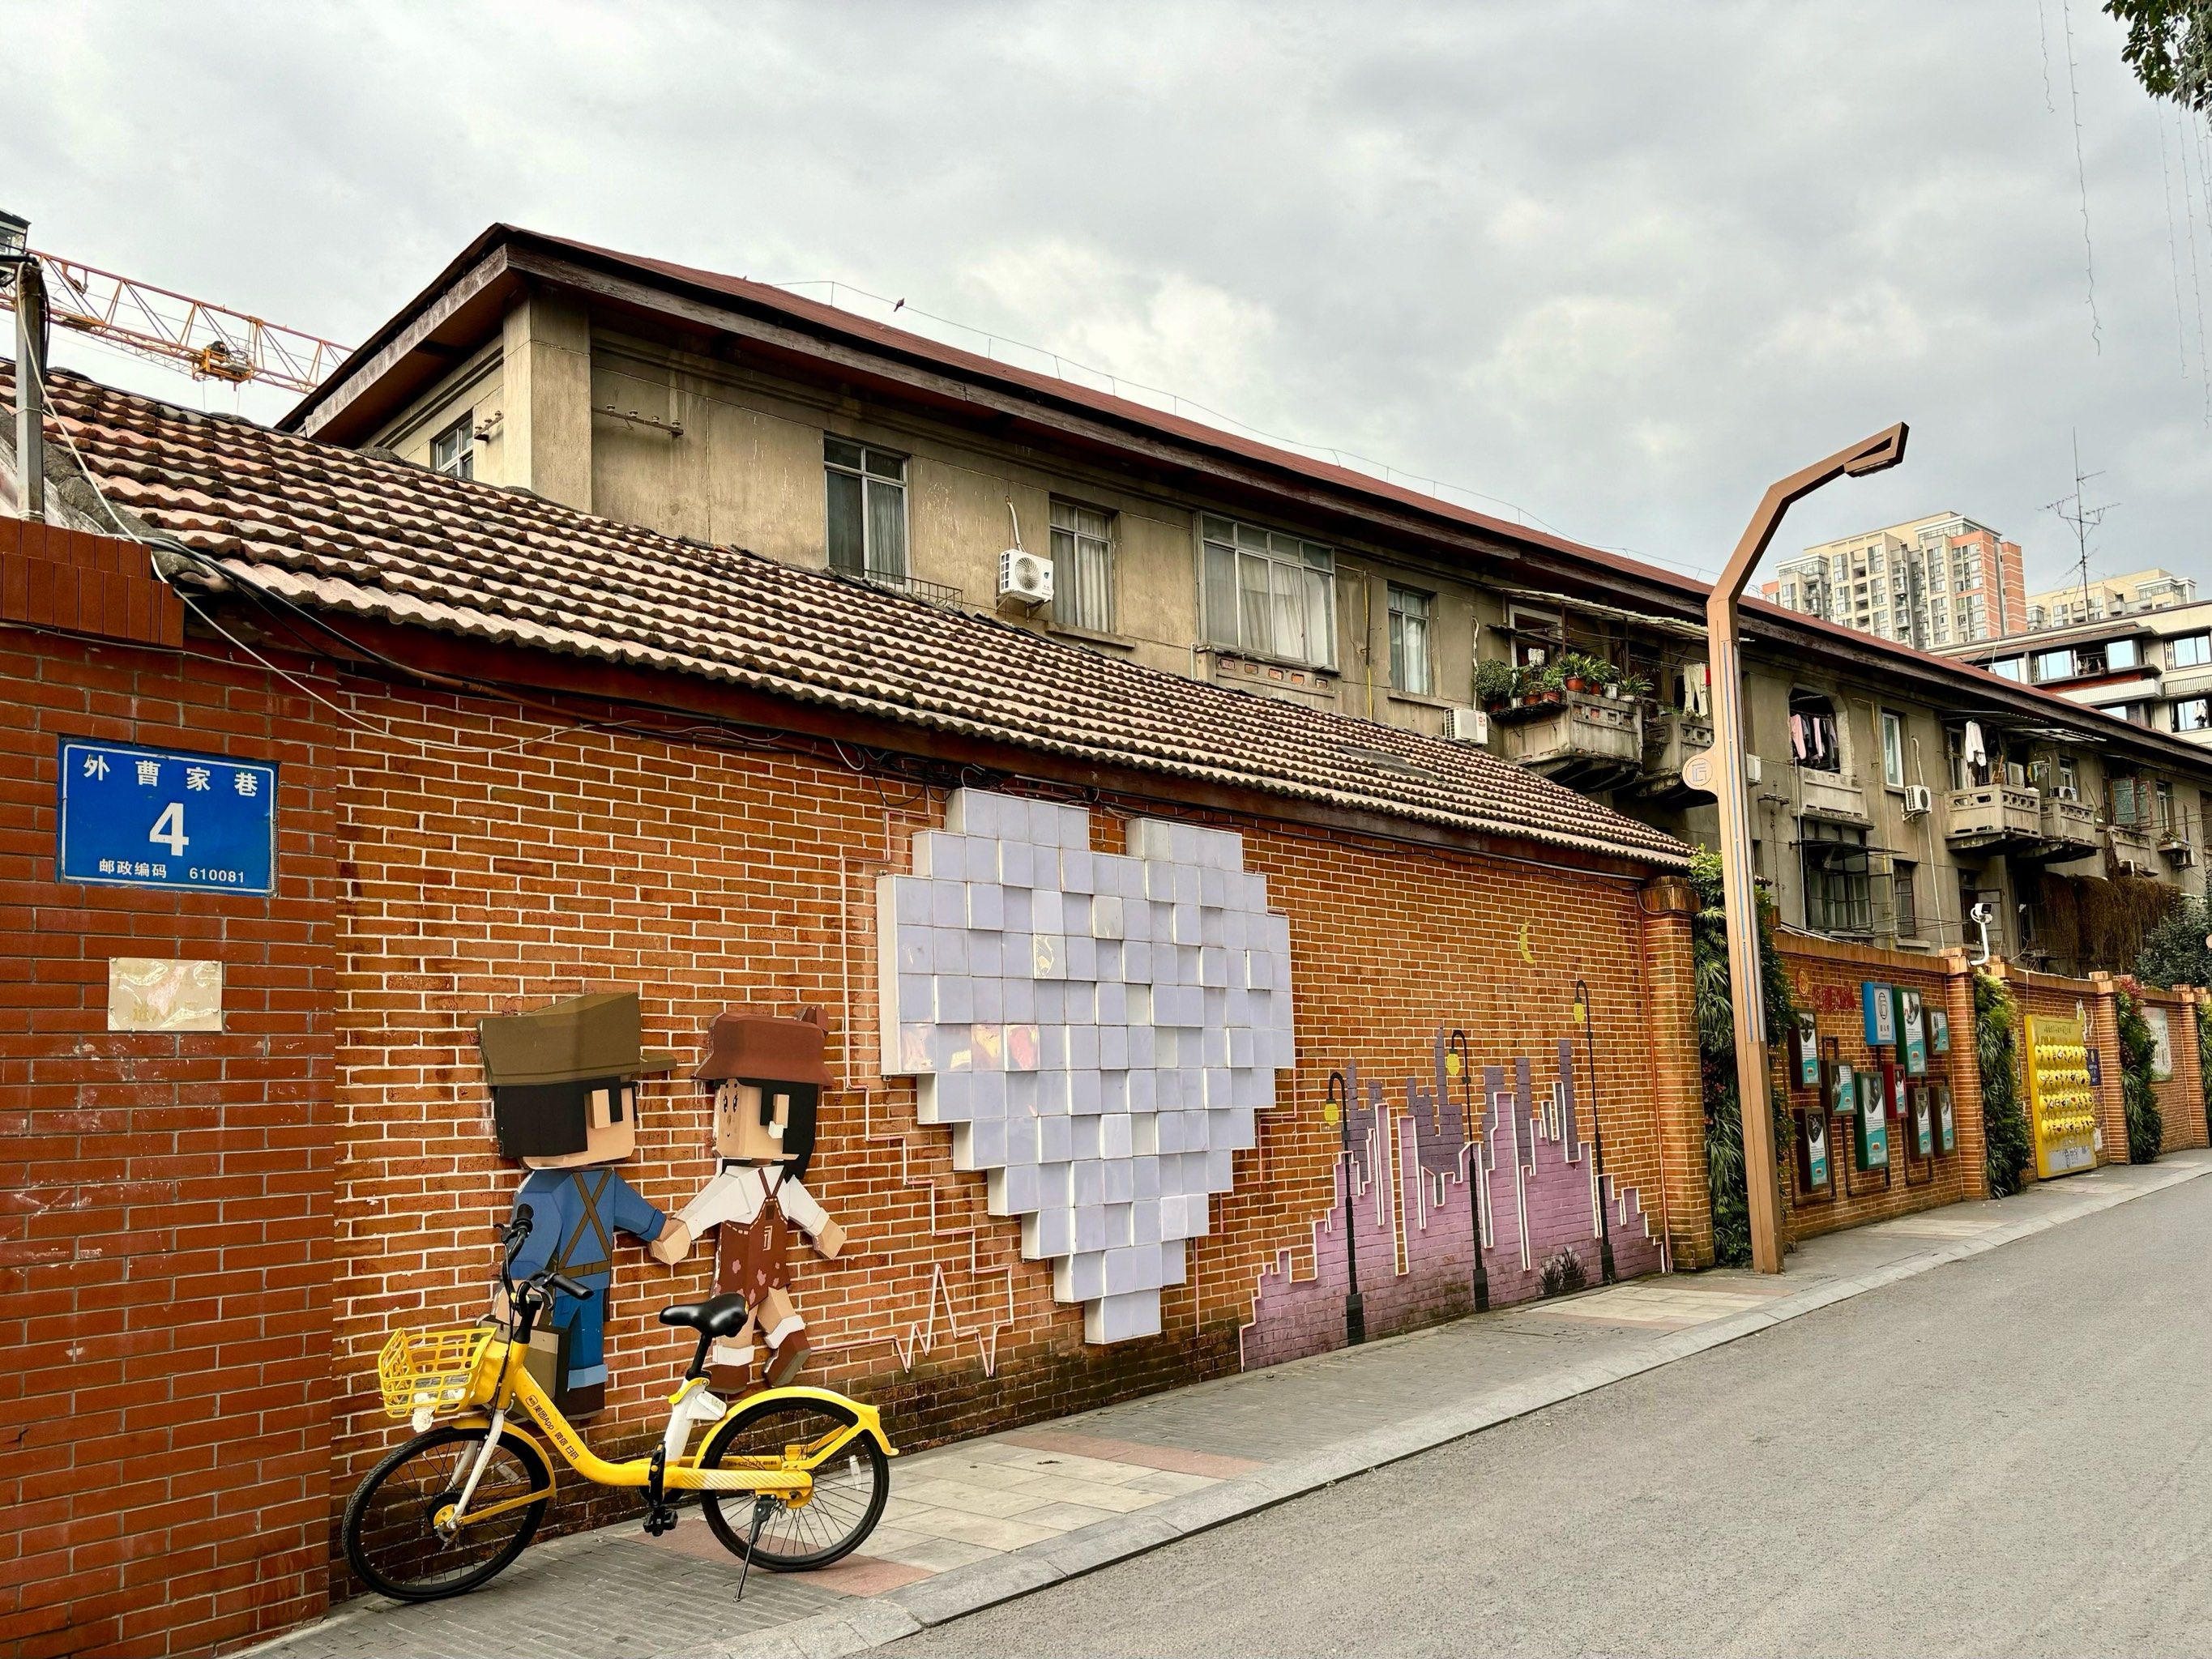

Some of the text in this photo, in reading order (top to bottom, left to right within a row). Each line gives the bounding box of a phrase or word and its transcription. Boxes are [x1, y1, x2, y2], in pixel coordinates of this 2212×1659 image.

[83, 755, 258, 797] 外曹家巷
[149, 802, 190, 856] 4
[99, 859, 244, 883] 邮政编码 610081
